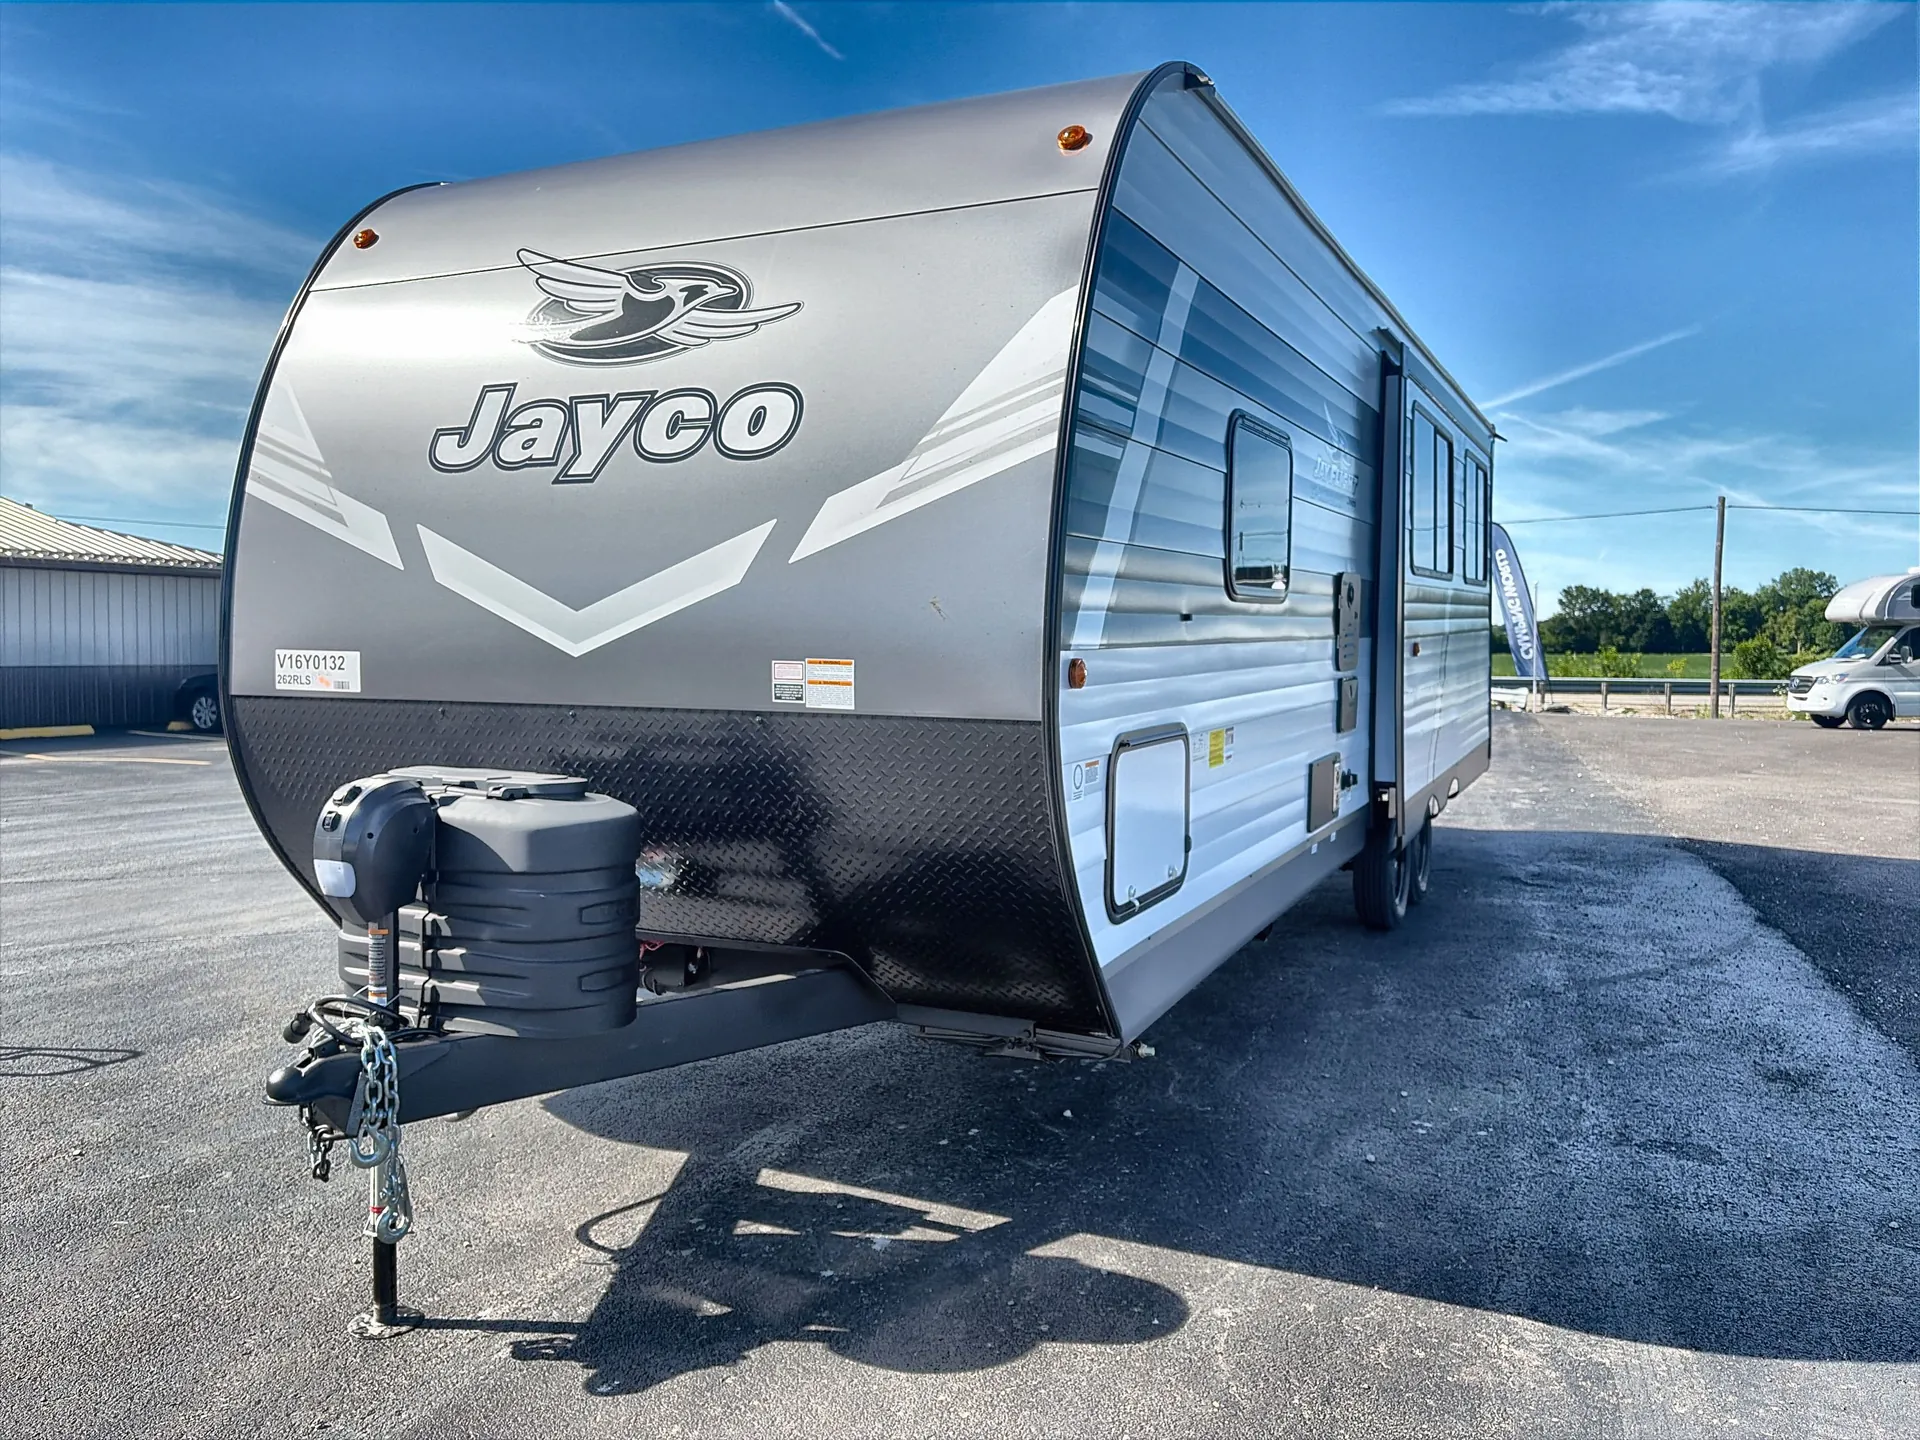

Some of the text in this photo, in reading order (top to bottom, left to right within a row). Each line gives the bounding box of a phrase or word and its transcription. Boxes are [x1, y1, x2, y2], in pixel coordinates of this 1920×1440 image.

[428, 380, 805, 486] Jayco
[277, 653, 345, 671] V16Y0132
[277, 674, 311, 685] 262RLS
